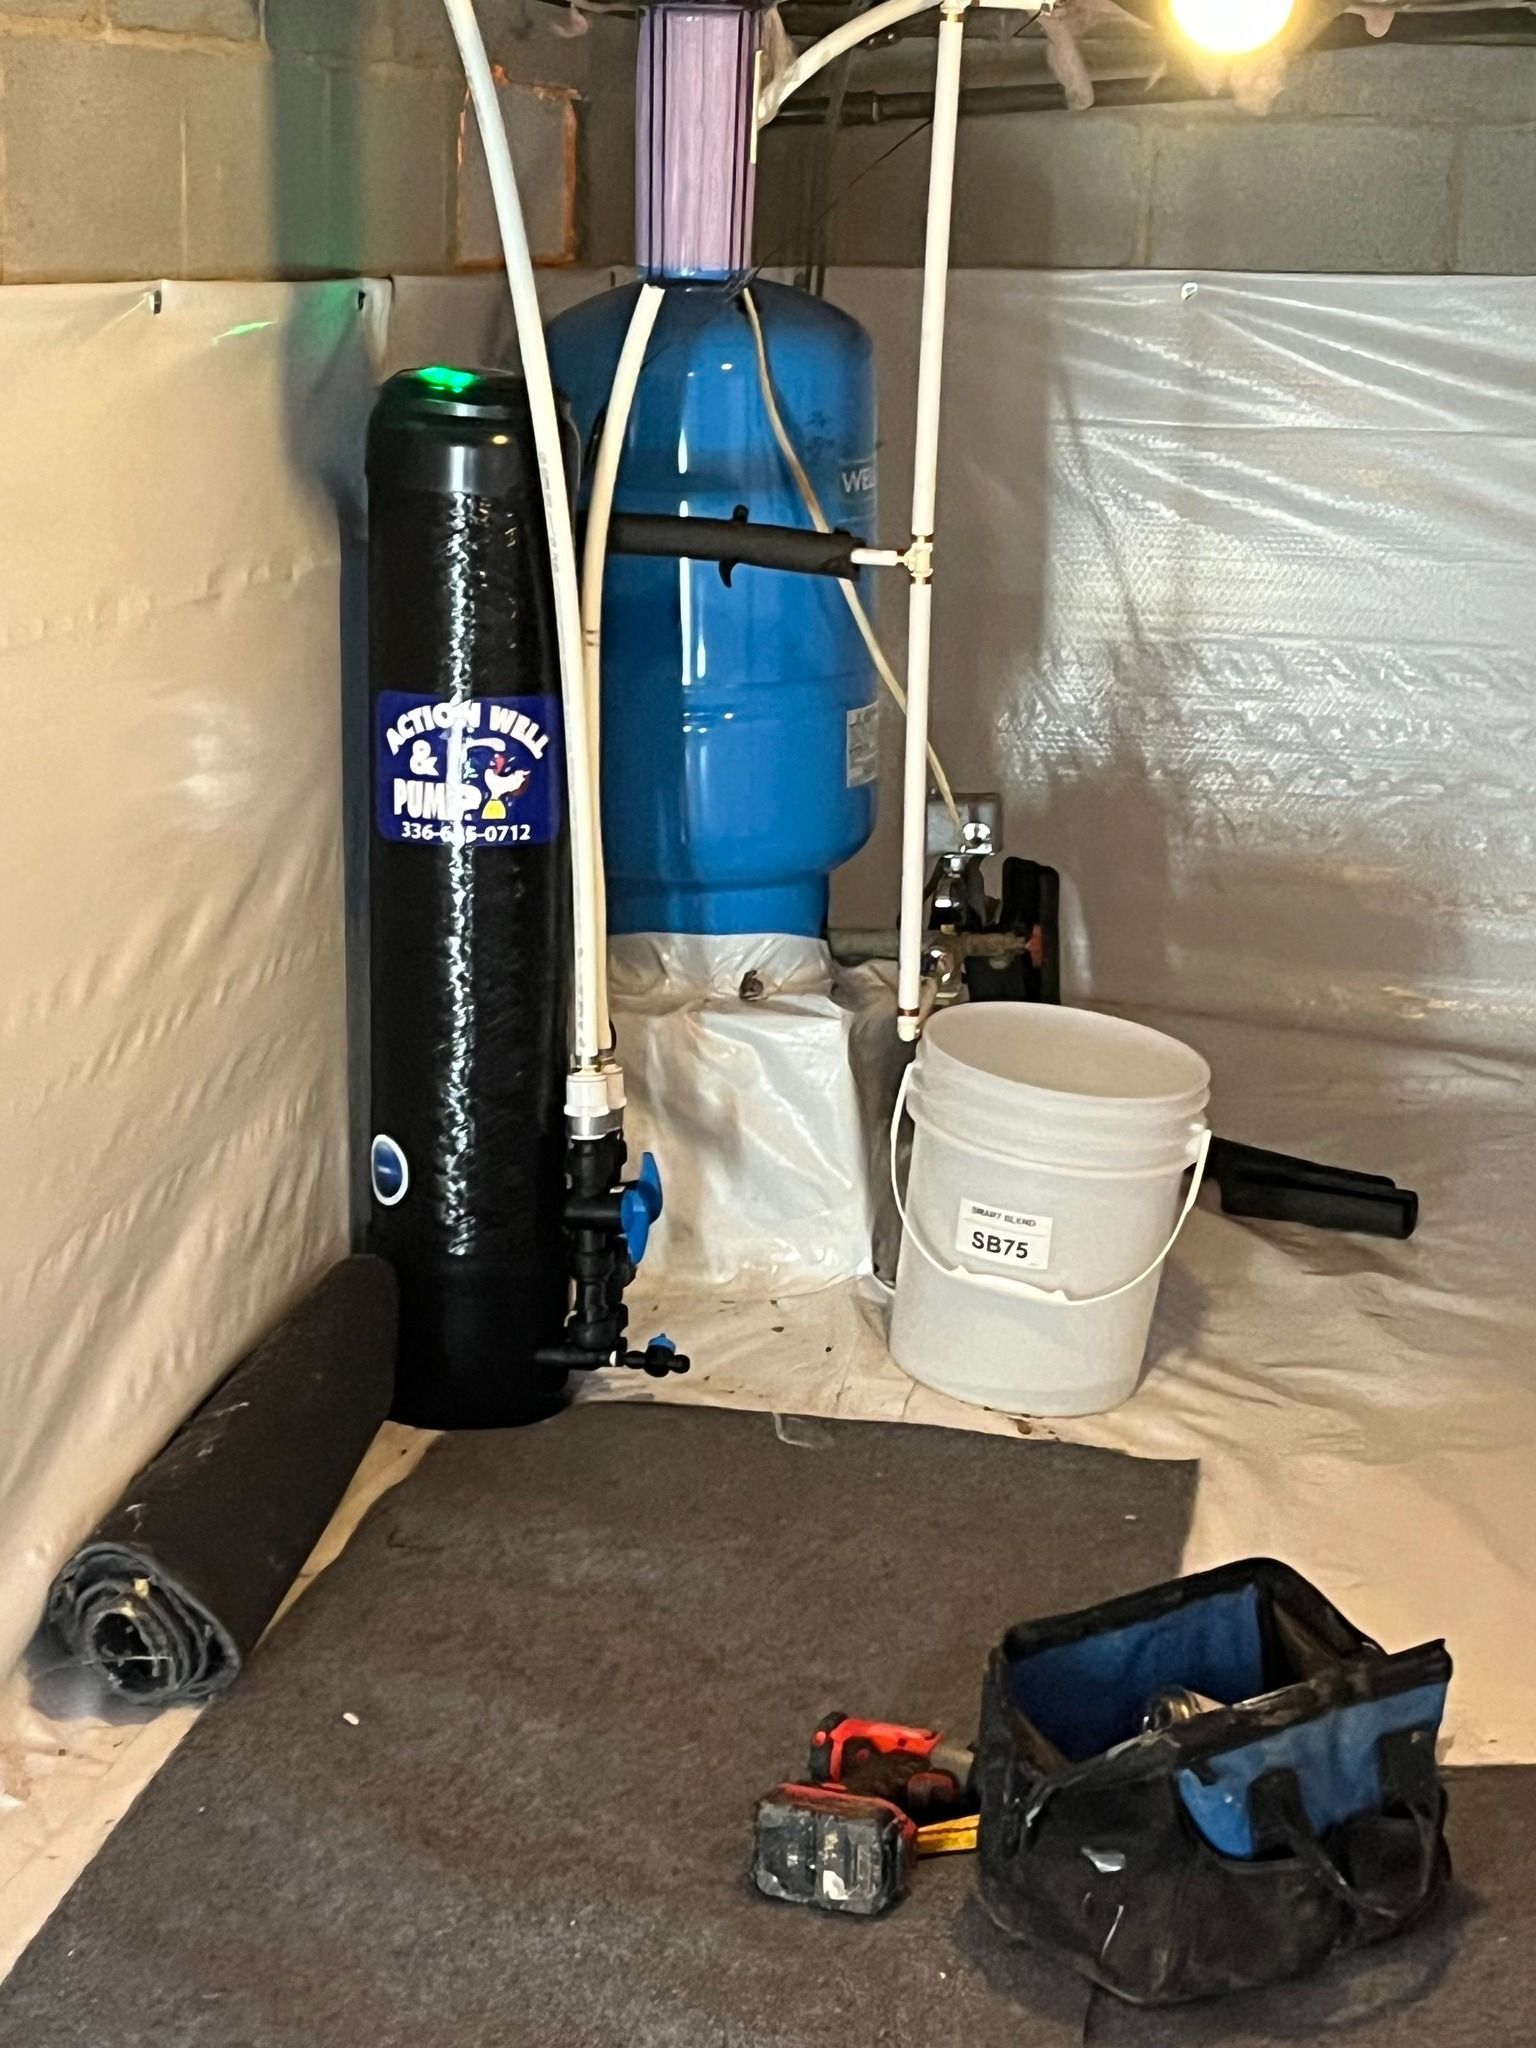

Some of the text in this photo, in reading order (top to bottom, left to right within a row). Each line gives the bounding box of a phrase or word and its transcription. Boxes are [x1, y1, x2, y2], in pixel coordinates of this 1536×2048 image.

[386, 701, 550, 760] ACTION WELL
[409, 739, 440, 776] &
[401, 820, 531, 842] 336-65-0712
[1004, 1214, 1037, 1227] BLEND
[971, 1231, 1029, 1259] SB75
